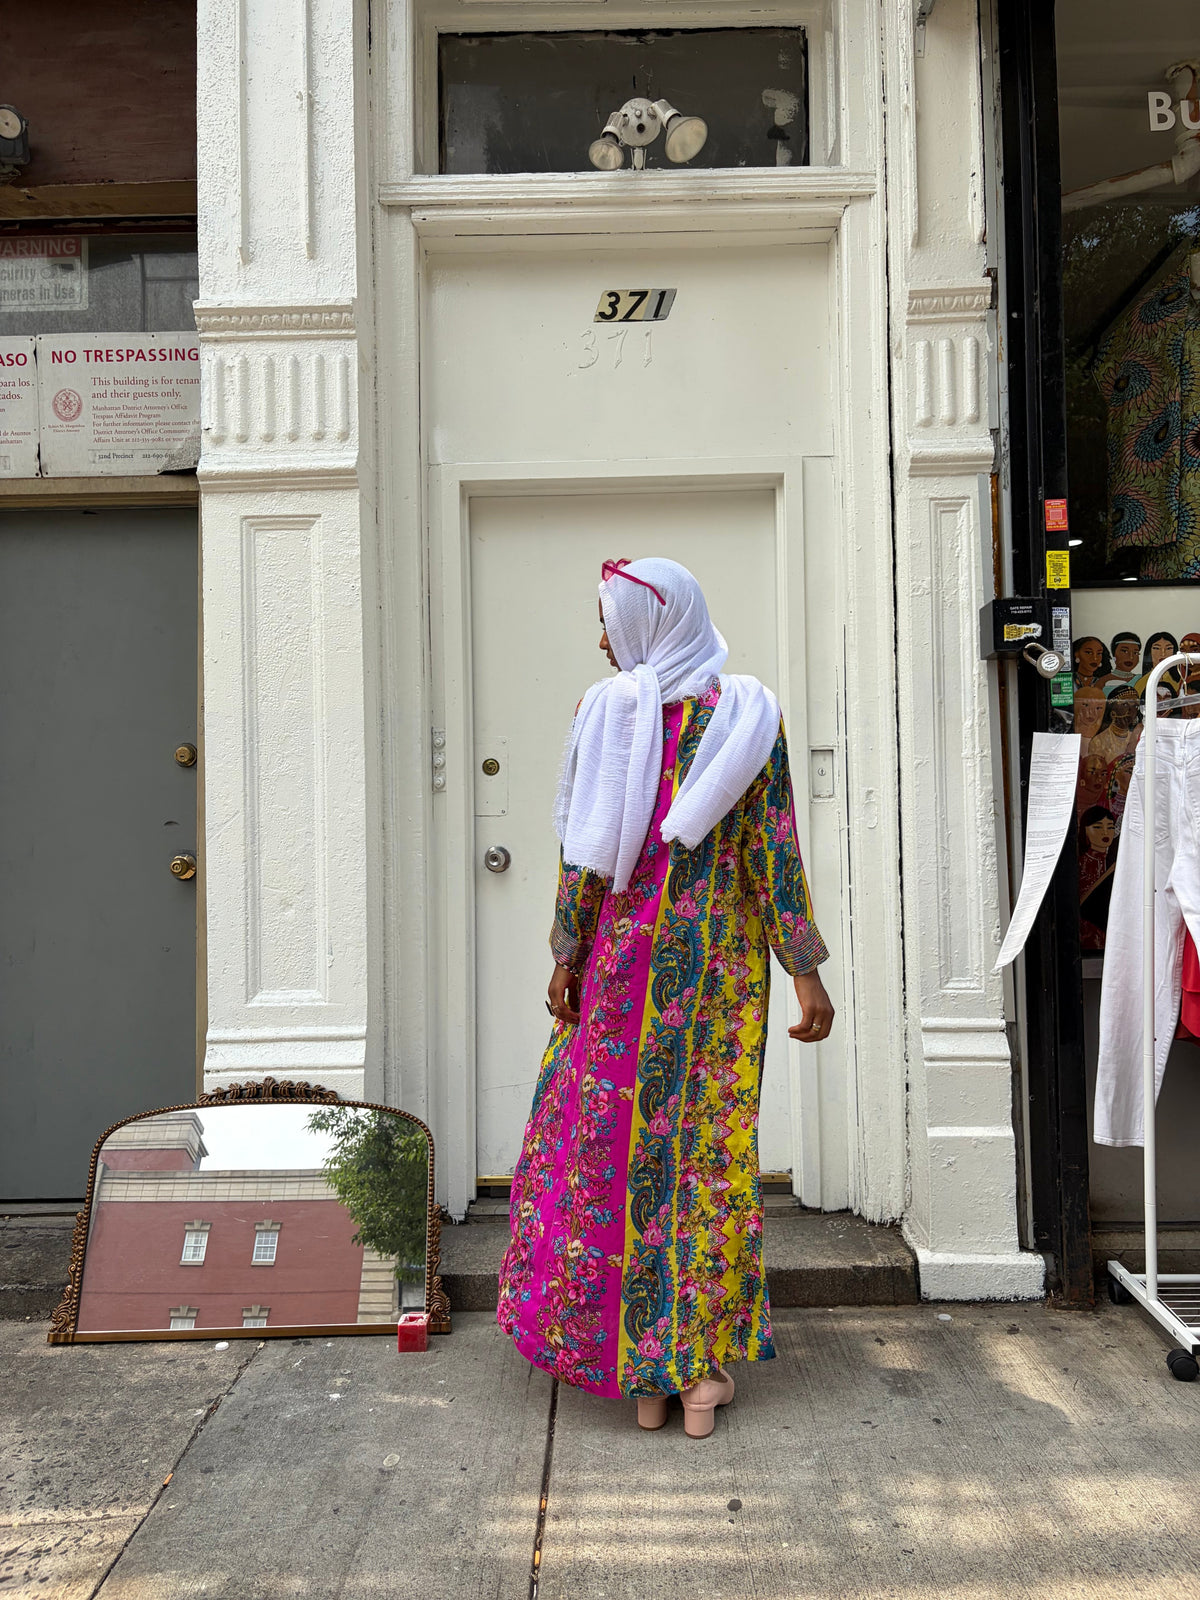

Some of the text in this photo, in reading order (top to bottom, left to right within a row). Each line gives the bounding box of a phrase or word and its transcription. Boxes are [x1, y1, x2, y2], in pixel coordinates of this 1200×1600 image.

[0, 239, 76, 257] ARNING
[54, 283, 75, 299] Use
[598, 290, 667, 320] 371
[51, 347, 199, 364] NO TRESPASSING
[578, 329, 653, 369] 371
[91, 376, 111, 386] This
[113, 376, 150, 388] building
[152, 376, 159, 385] is
[160, 375, 173, 385] for
[91, 388, 182, 400] and their guests only.
